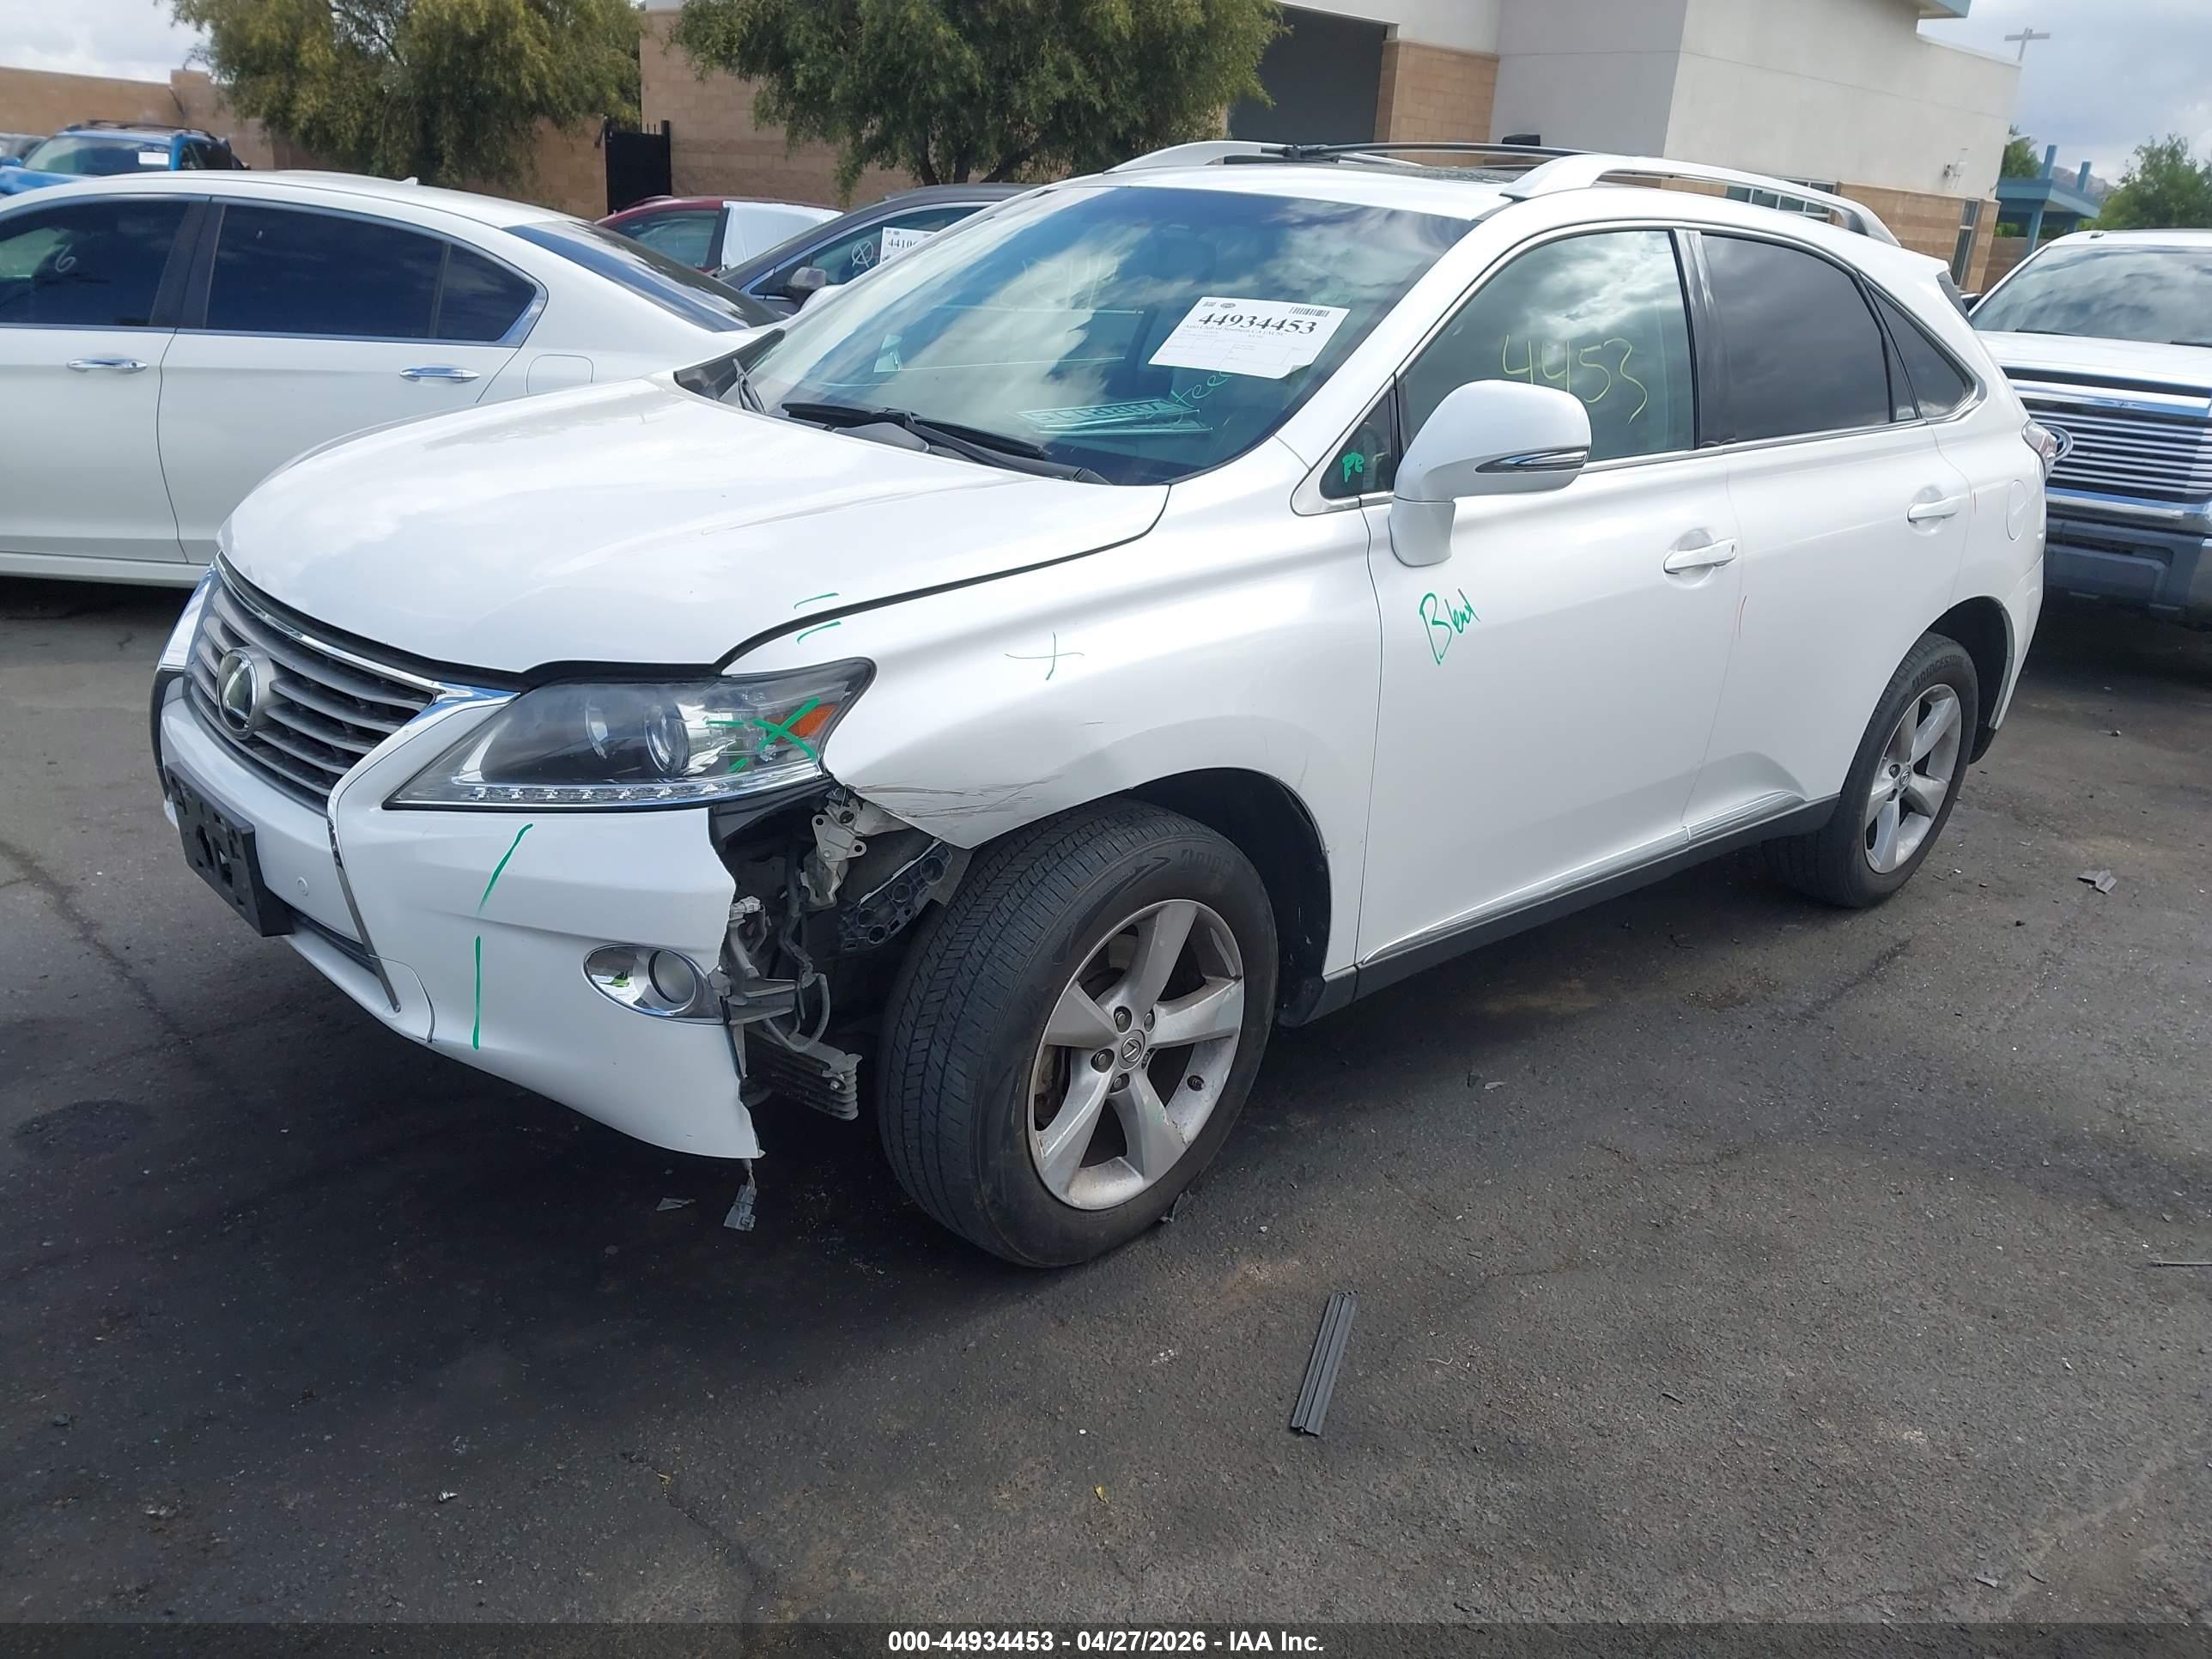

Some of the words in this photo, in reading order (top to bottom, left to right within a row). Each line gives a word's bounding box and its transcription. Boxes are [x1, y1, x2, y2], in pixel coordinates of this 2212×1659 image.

[54, 244, 76, 273] 6
[1198, 313, 1318, 335] 44934453
[1501, 333, 1648, 425] 4453
